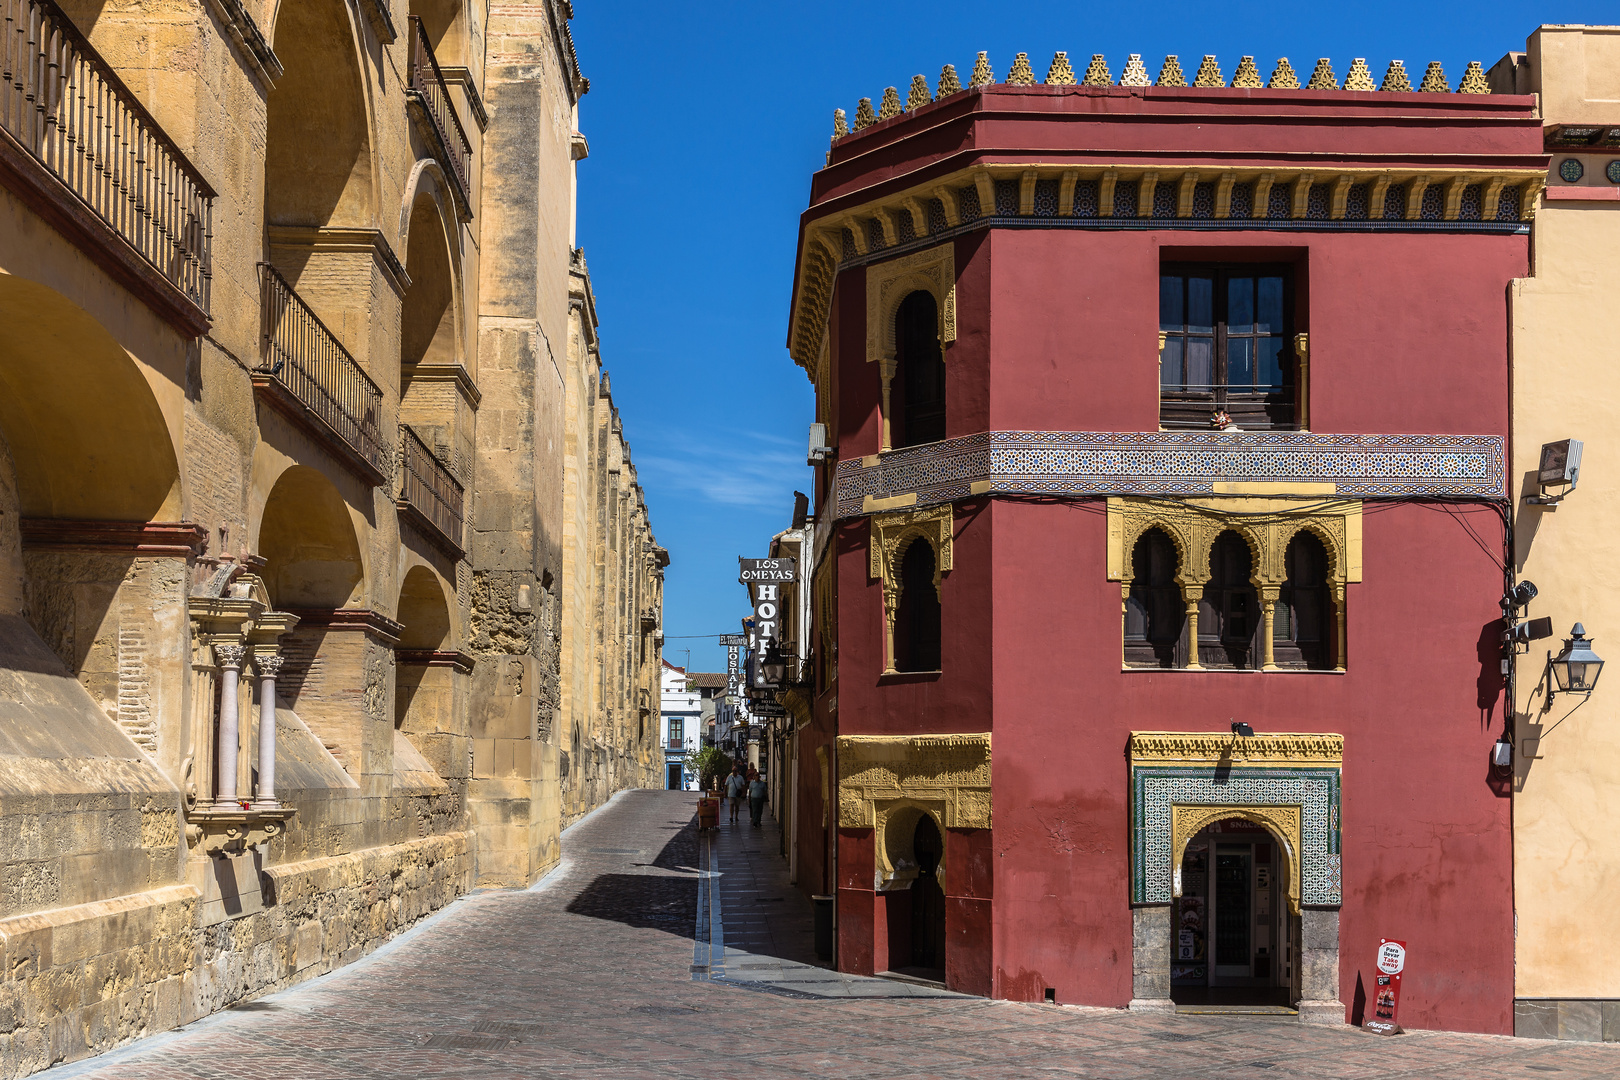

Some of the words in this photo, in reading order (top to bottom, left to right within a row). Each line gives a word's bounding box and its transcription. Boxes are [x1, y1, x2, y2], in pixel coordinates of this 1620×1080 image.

[756, 560, 779, 569] LOS
[741, 570, 793, 580] OMEYAS
[728, 646, 738, 689] HOSTAL
